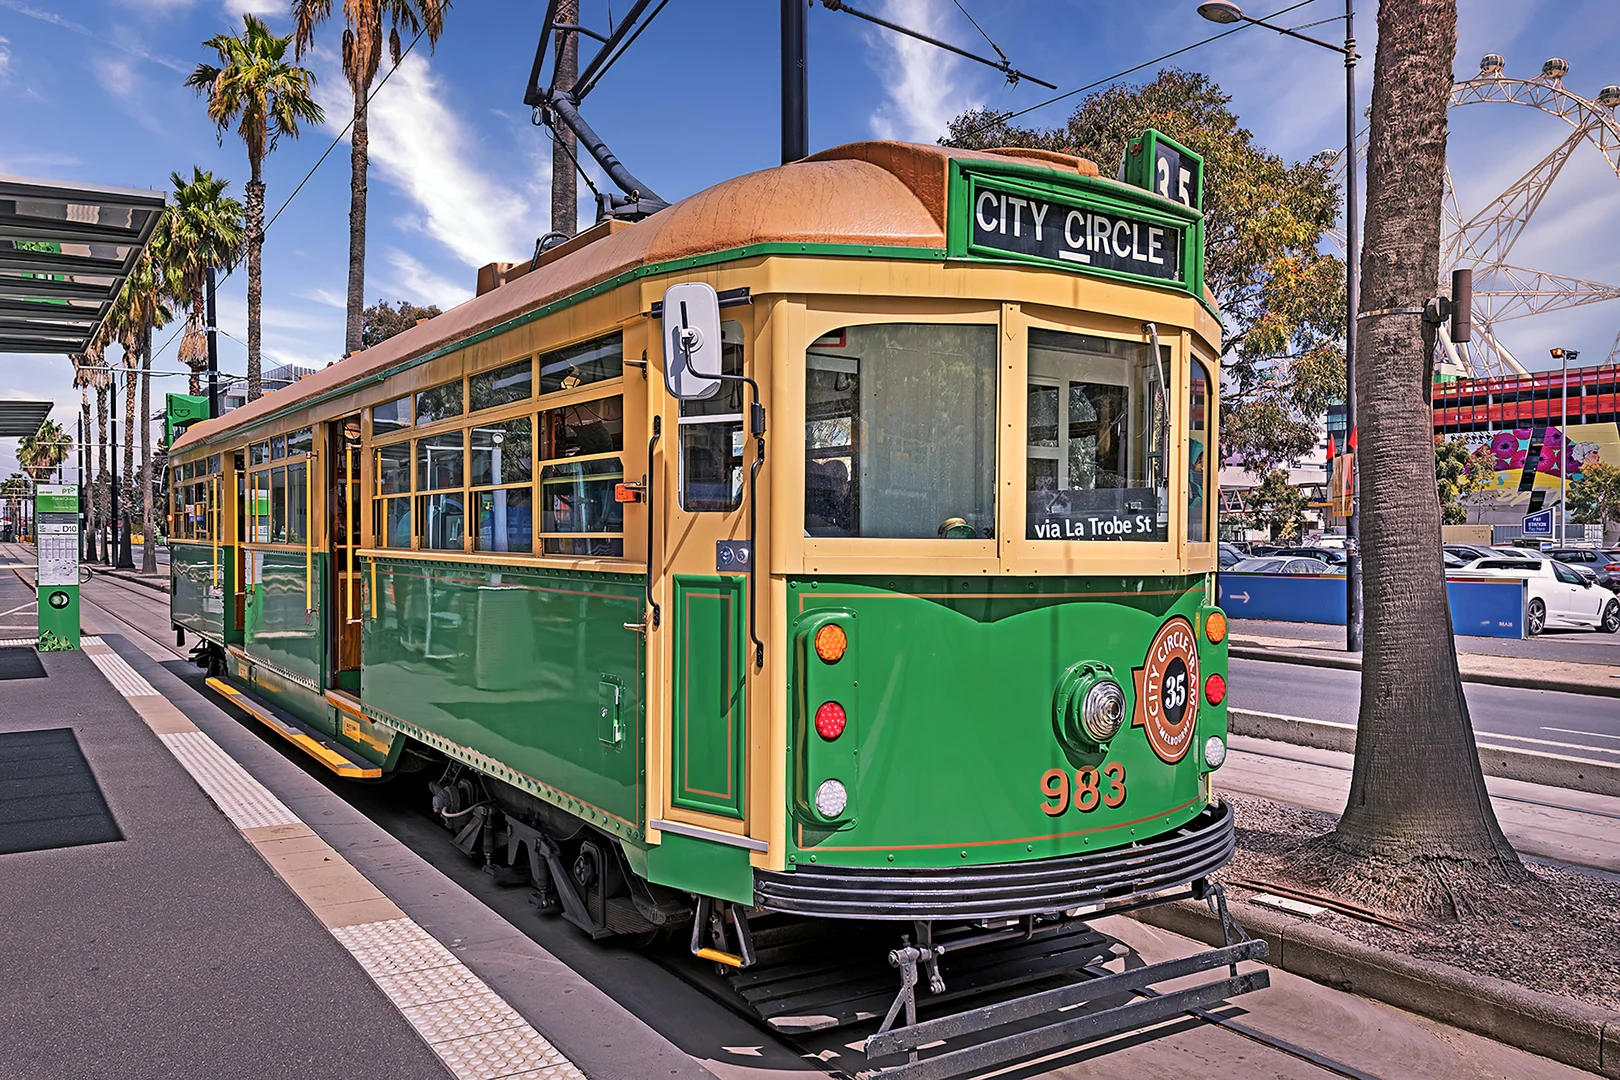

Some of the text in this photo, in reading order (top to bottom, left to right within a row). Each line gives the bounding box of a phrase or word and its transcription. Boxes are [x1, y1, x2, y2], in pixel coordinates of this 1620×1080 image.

[976, 191, 1164, 264] CITY CIRCLE
[1034, 515, 1152, 538] via La Trobe St
[1148, 631, 1196, 716] CITY CIRCLE TRAM
[1165, 672, 1185, 709] 35
[1040, 761, 1126, 816] 983
